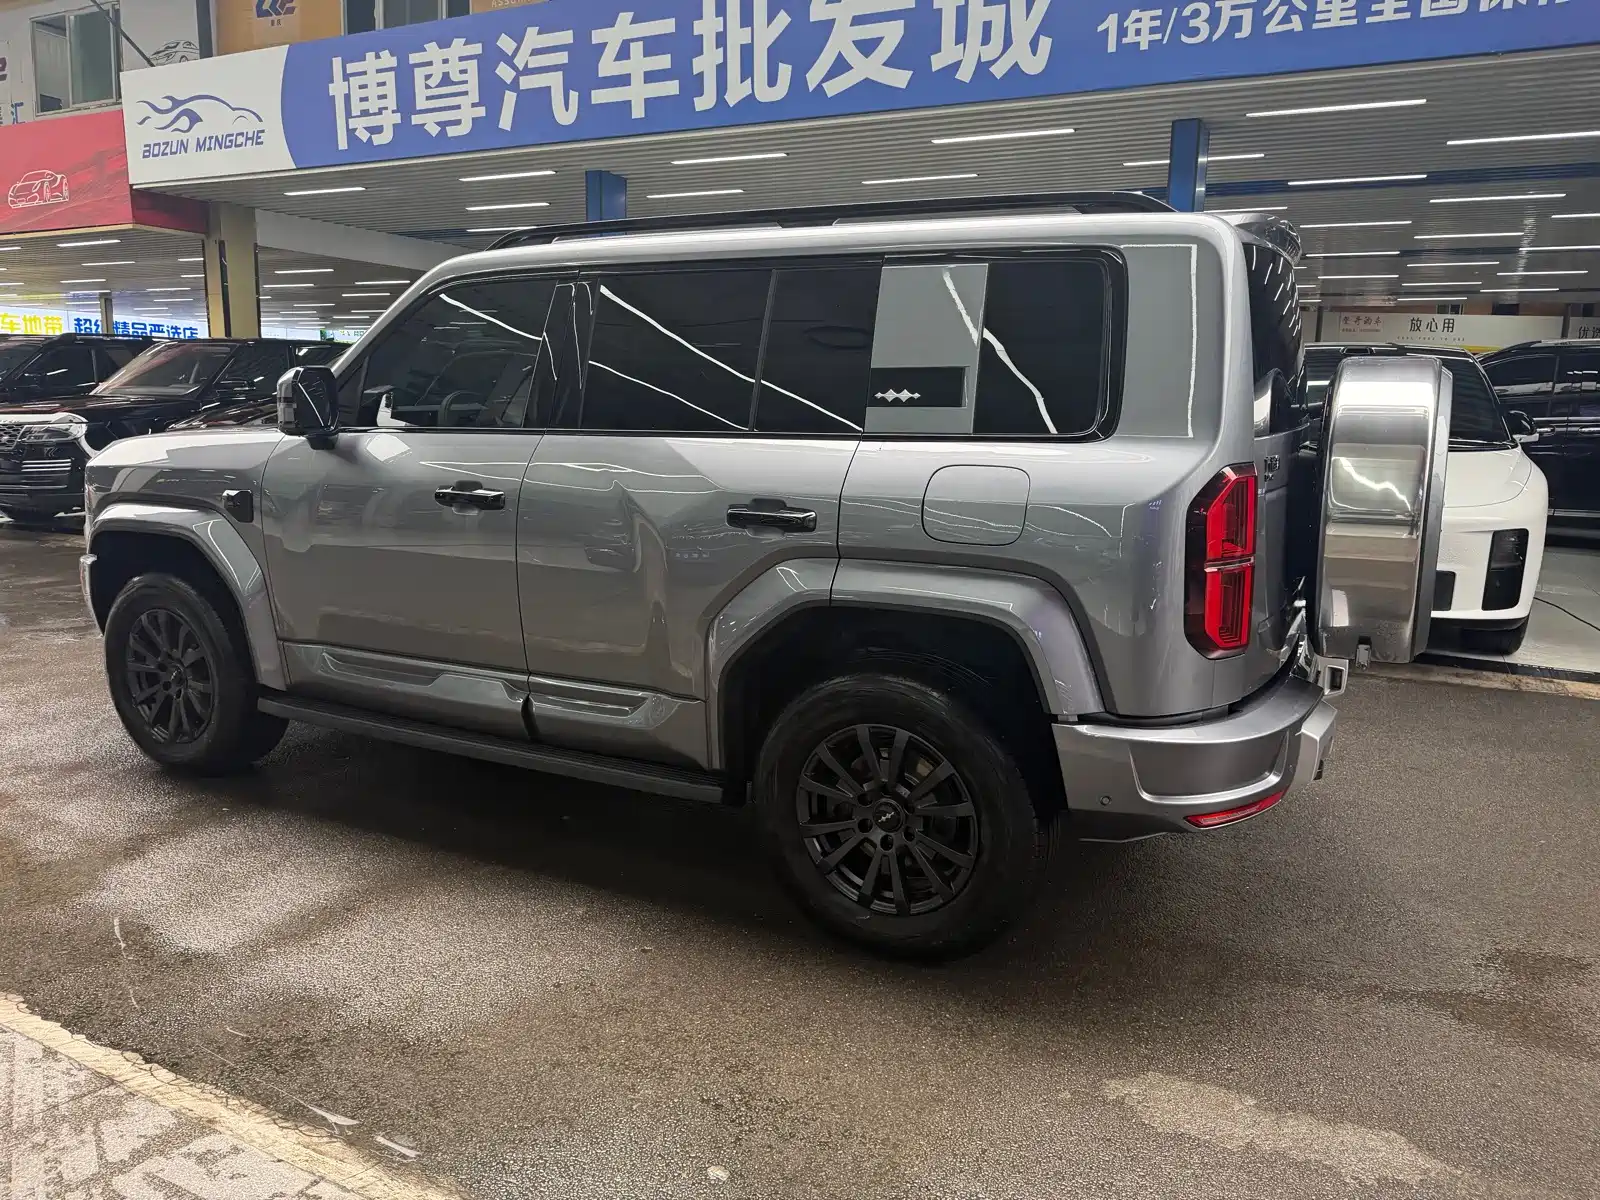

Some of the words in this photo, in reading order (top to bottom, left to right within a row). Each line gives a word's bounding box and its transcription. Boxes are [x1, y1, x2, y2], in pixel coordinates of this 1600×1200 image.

[329, 0, 1052, 150] 博尊汽车批发城
[142, 139, 189, 159] BOZUN
[195, 129, 266, 152] MINGCHE
[1409, 317, 1455, 333] 放心用
